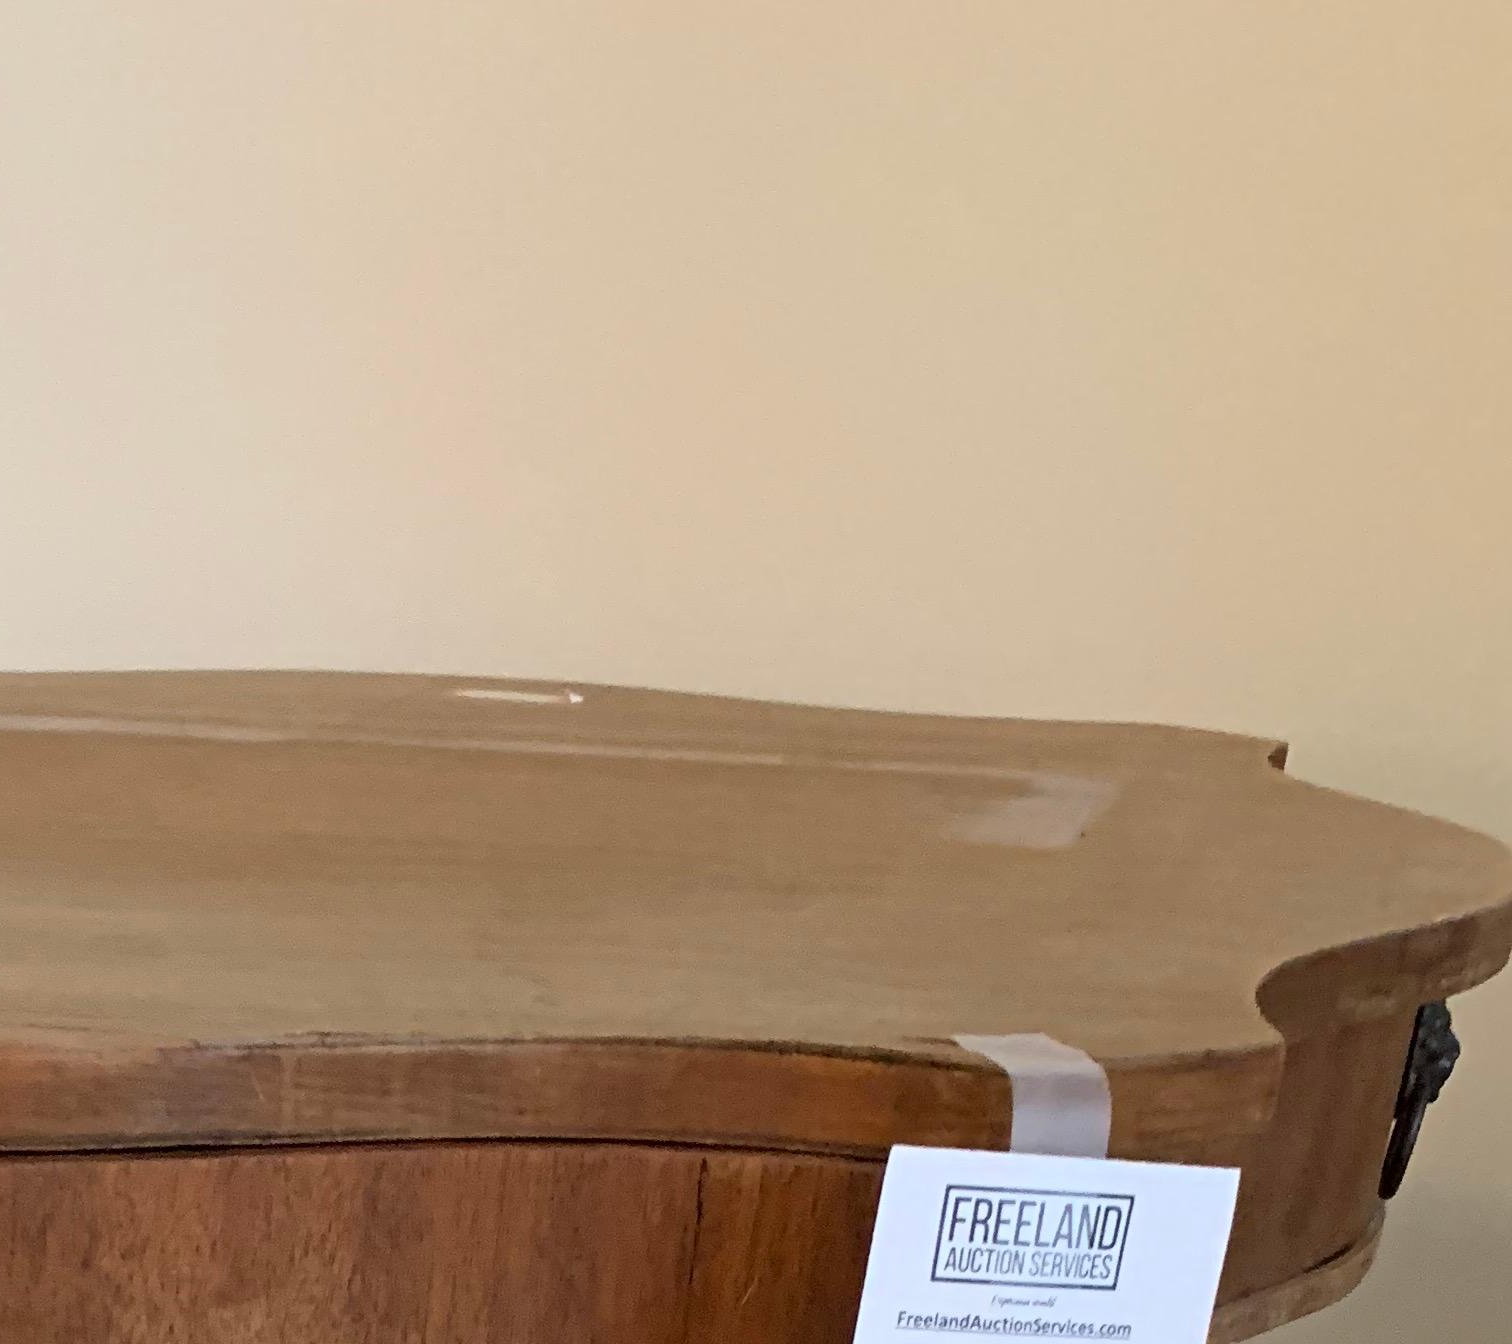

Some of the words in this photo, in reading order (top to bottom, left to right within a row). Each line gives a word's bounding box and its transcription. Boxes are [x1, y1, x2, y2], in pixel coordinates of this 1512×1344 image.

[947, 1196, 1123, 1251] FREELAND
[944, 1247, 1026, 1276] AUCTION
[1028, 1252, 1114, 1280] SERVICES
[897, 1311, 1132, 1337] FreelandAuctionServices.com
